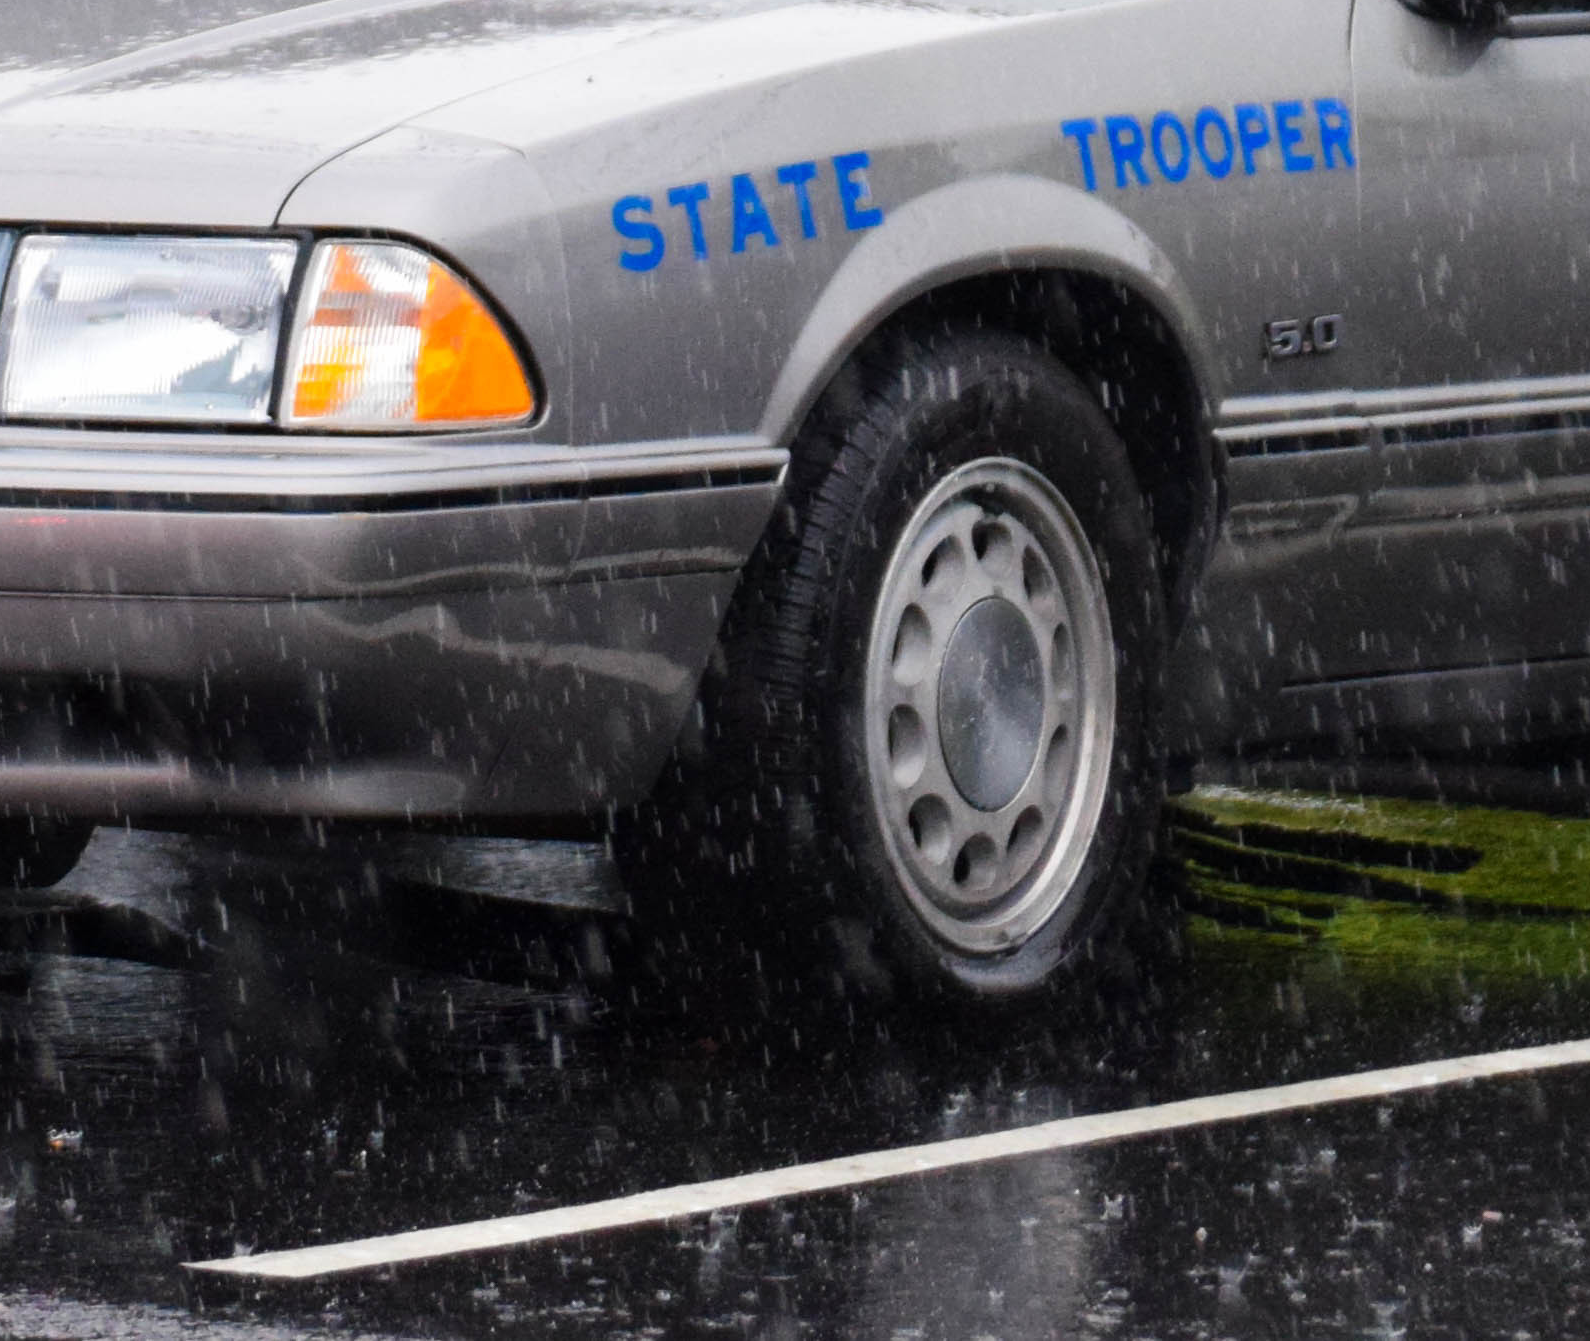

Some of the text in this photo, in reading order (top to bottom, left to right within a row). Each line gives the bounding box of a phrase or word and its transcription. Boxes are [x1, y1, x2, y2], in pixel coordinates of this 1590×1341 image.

[610, 98, 1356, 273] STATE TROOPER
[1267, 313, 1346, 356] 5.0
